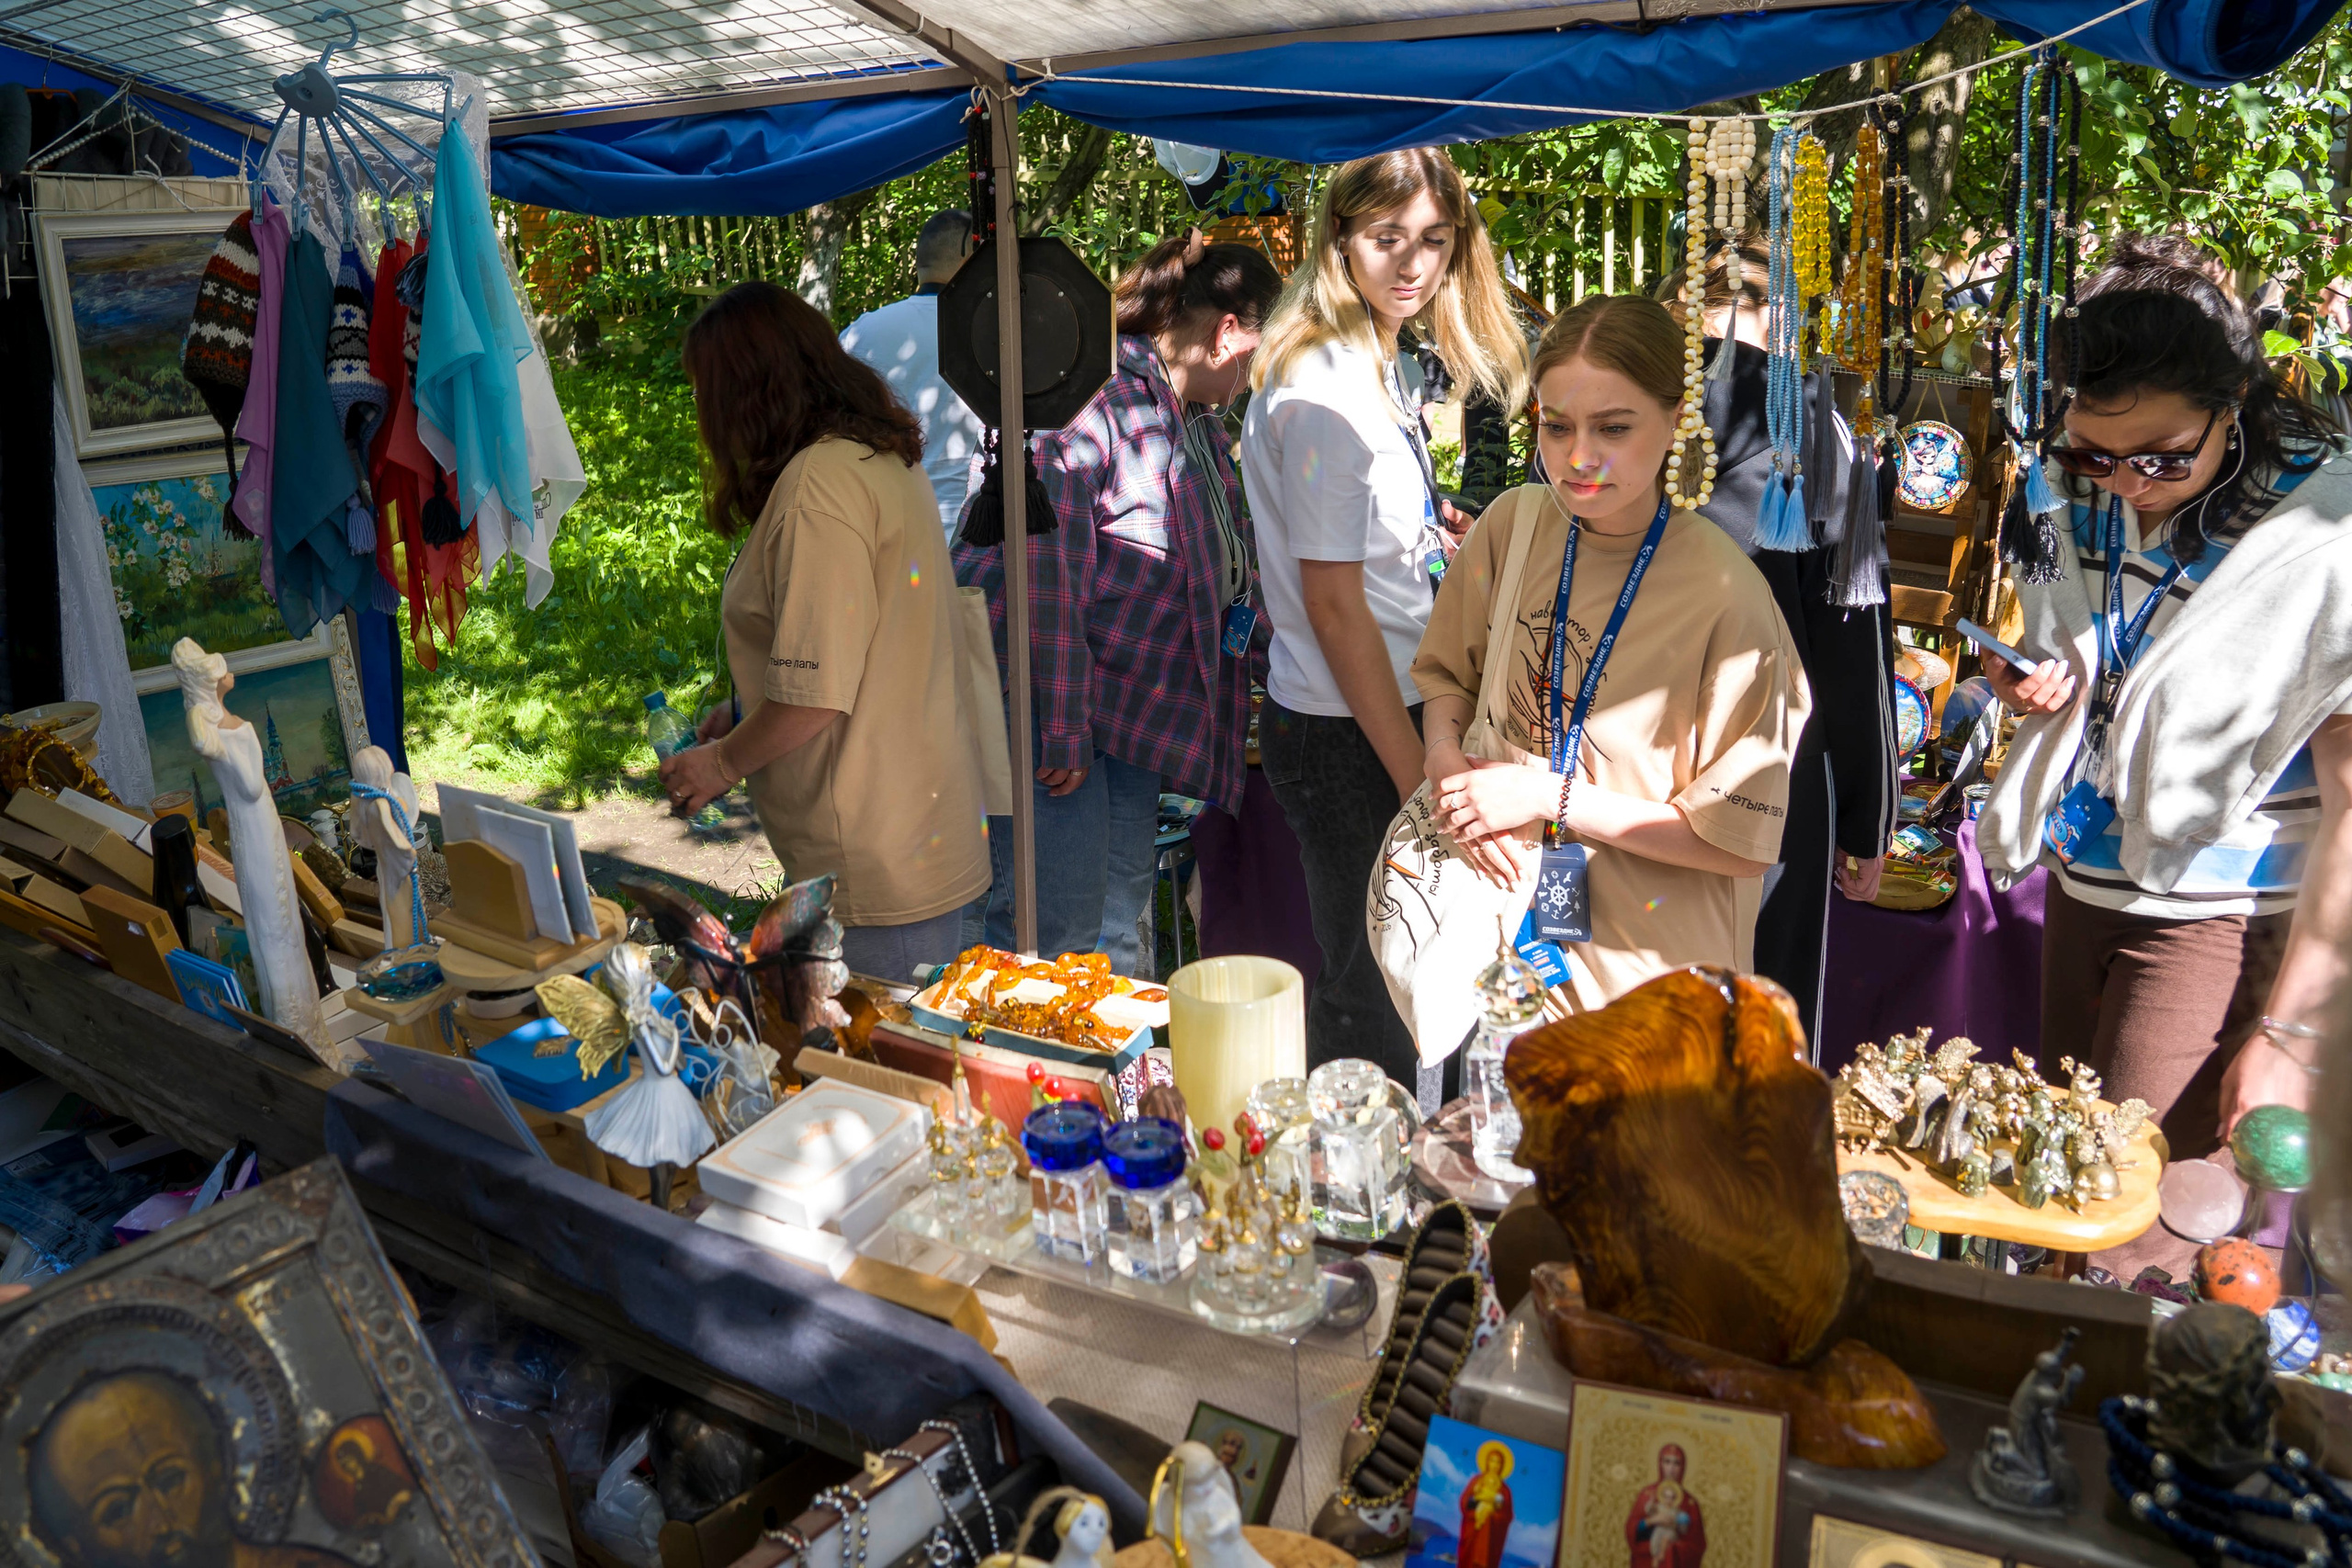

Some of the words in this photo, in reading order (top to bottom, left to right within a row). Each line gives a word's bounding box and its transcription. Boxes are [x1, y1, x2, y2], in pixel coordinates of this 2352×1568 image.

[1562, 542, 1575, 595] СОЗВЕЗДИЕ
[1620, 556, 1646, 608] СОЗВЕЗДИЕ
[794, 660, 820, 670] лапы
[1553, 636, 1563, 689] СОЗВЕЗДИЕ
[1582, 646, 1607, 698] СОЗВЕЗДИЕ
[1724, 791, 1770, 815] четыре
